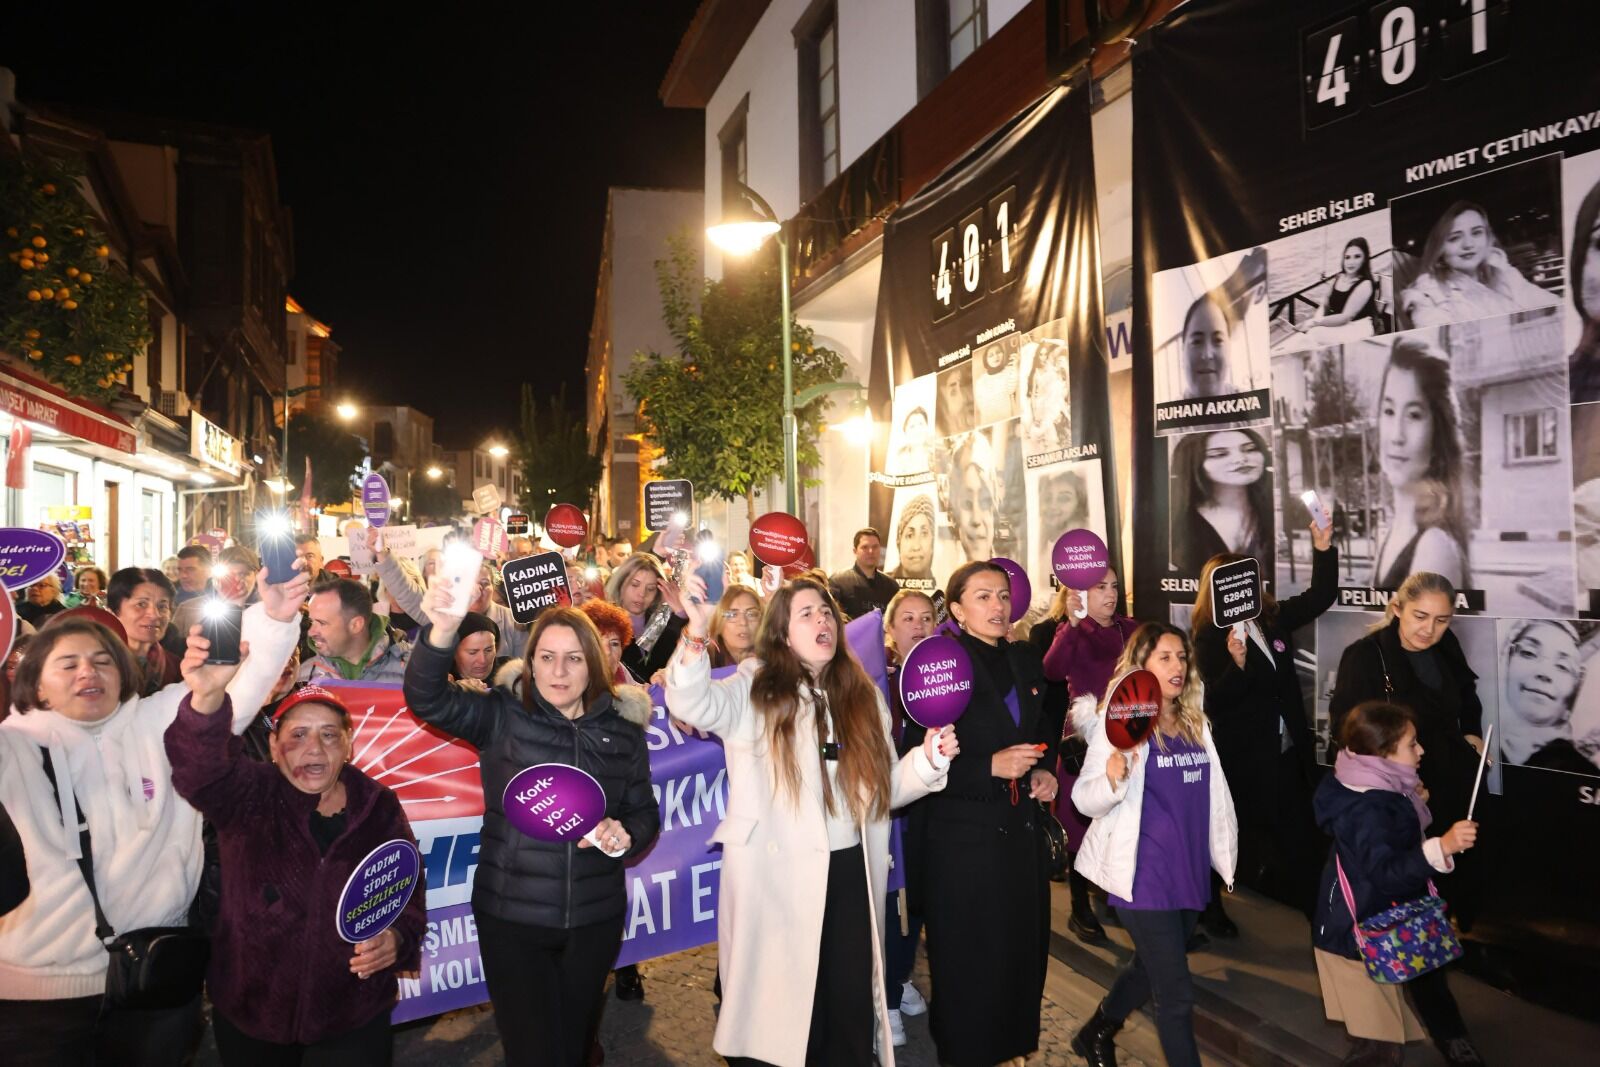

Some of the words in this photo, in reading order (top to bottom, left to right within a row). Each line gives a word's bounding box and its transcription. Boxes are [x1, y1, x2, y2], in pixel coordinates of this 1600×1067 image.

[1406, 148, 1479, 183] KIYMET
[1279, 206, 1328, 233] SEHER
[1329, 192, 1375, 219] İŞLER
[936, 201, 1011, 306] 401
[1157, 403, 1203, 421] RUHAN
[1205, 396, 1261, 415] AKKAYA
[1063, 544, 1096, 554] YAŞASIN
[1068, 553, 1093, 562] KADIN
[508, 562, 558, 583] KADINA
[1055, 560, 1107, 571] DAYANIŞMASI!
[512, 575, 565, 599] ŞİDDETE
[905, 578, 933, 590] GERÇEK
[1160, 578, 1199, 592] SELEN
[516, 592, 558, 613] HAYIR!
[1223, 587, 1253, 604] 6284'ü
[1341, 585, 1389, 606] PELİN
[1223, 600, 1255, 617] uygula!
[917, 658, 957, 674] YAŞASIN
[923, 671, 953, 686] KADIN
[906, 679, 971, 702] DAYANIŞMASI!
[1156, 753, 1174, 768] Her
[1183, 767, 1202, 784] Hayır!
[515, 776, 554, 805] Kork-
[529, 794, 558, 815] mu-
[542, 807, 566, 827] yo-
[555, 812, 584, 836] ruz!
[364, 849, 401, 879] KADINA
[363, 866, 400, 898] ŞİDDET
[346, 875, 412, 923] SESSİZLİKTEN
[354, 895, 401, 934] BESLENİR!
